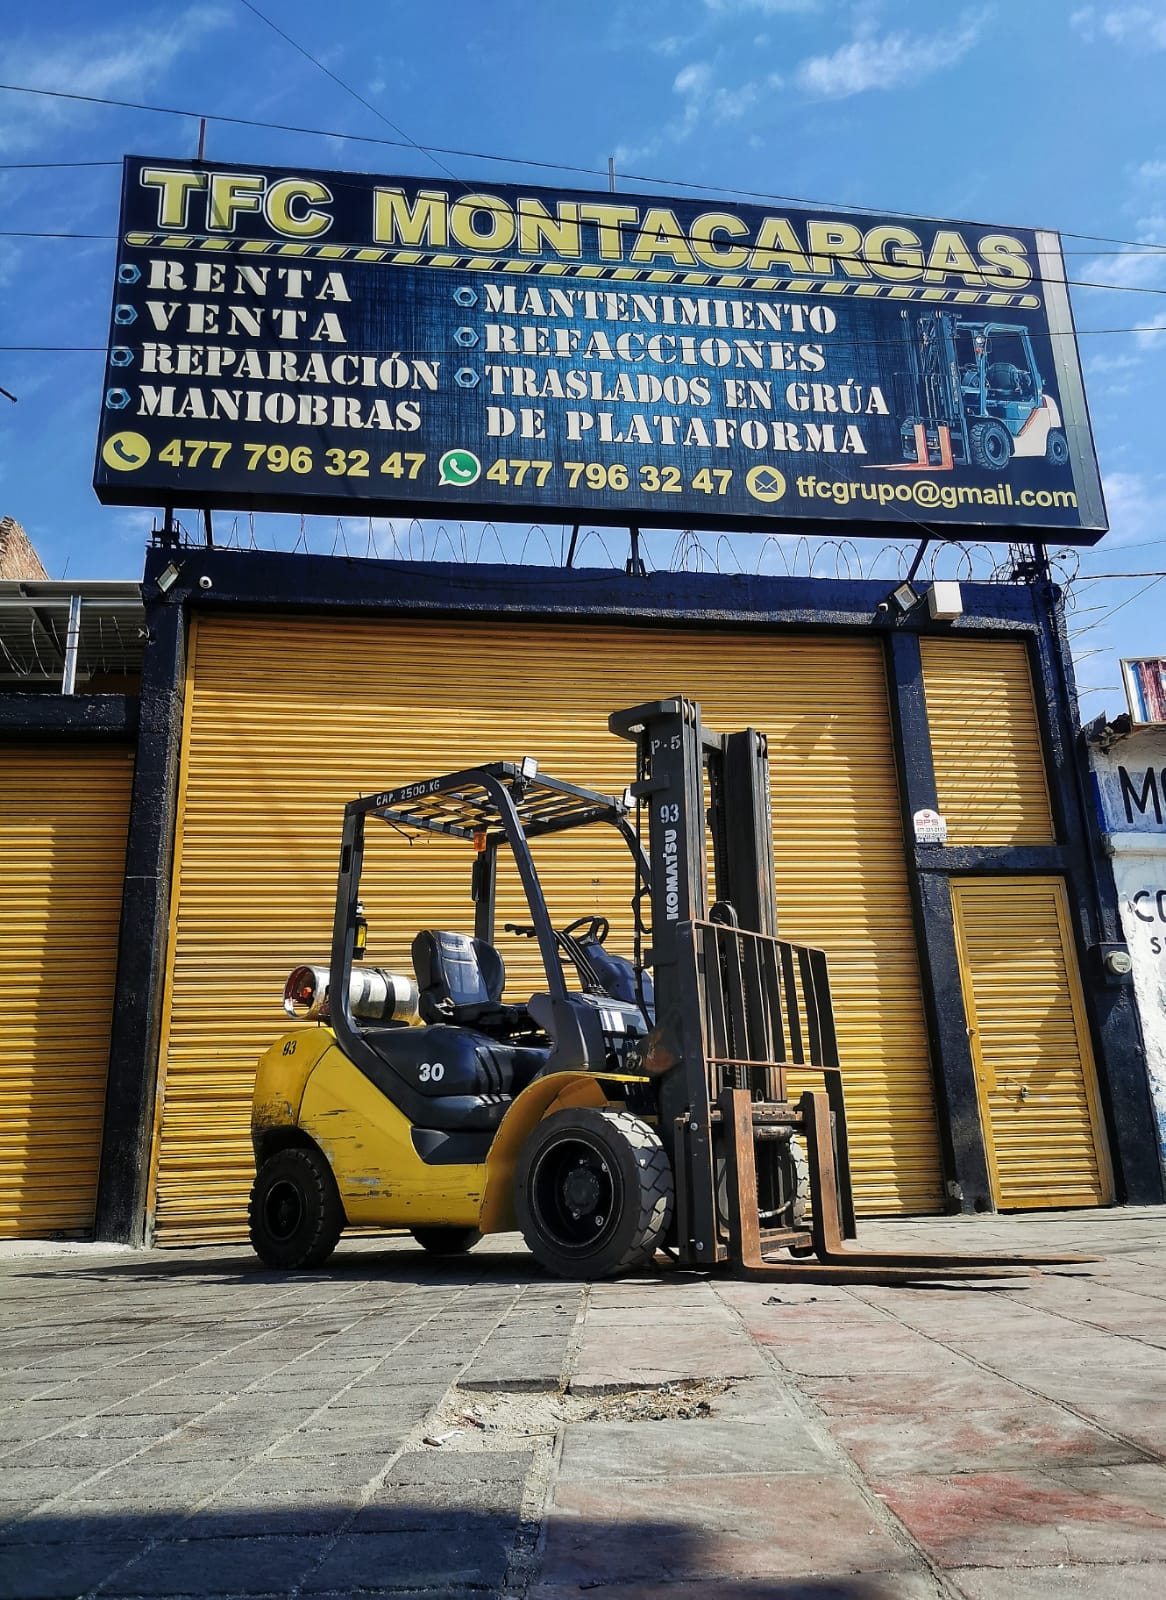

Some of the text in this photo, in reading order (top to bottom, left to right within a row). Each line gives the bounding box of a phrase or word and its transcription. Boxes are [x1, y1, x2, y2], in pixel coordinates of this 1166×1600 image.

[140, 167, 1033, 290] TFC MONTACARGAS
[147, 260, 352, 302] RENTA
[145, 301, 347, 343] VENTA
[483, 284, 837, 334] MANTENIMIENTO
[139, 342, 441, 391] REPARACIÓN
[484, 324, 825, 372] REFACCIONES
[136, 385, 422, 432] MANIOBRAS
[485, 365, 890, 415] TRASLADOS EN GRÚA
[486, 406, 868, 455] DE PLATAFORMA
[158, 439, 426, 480] 477 796 32 47
[486, 458, 733, 495] 477 796 32 47
[796, 476, 1078, 508] tfcgrupo@gmail.com
[660, 804, 680, 824] 93
[1118, 766, 1166, 825] M
[662, 829, 679, 921] KOMATSU
[282, 1040, 297, 1056] 93
[418, 1062, 445, 1082] 30
